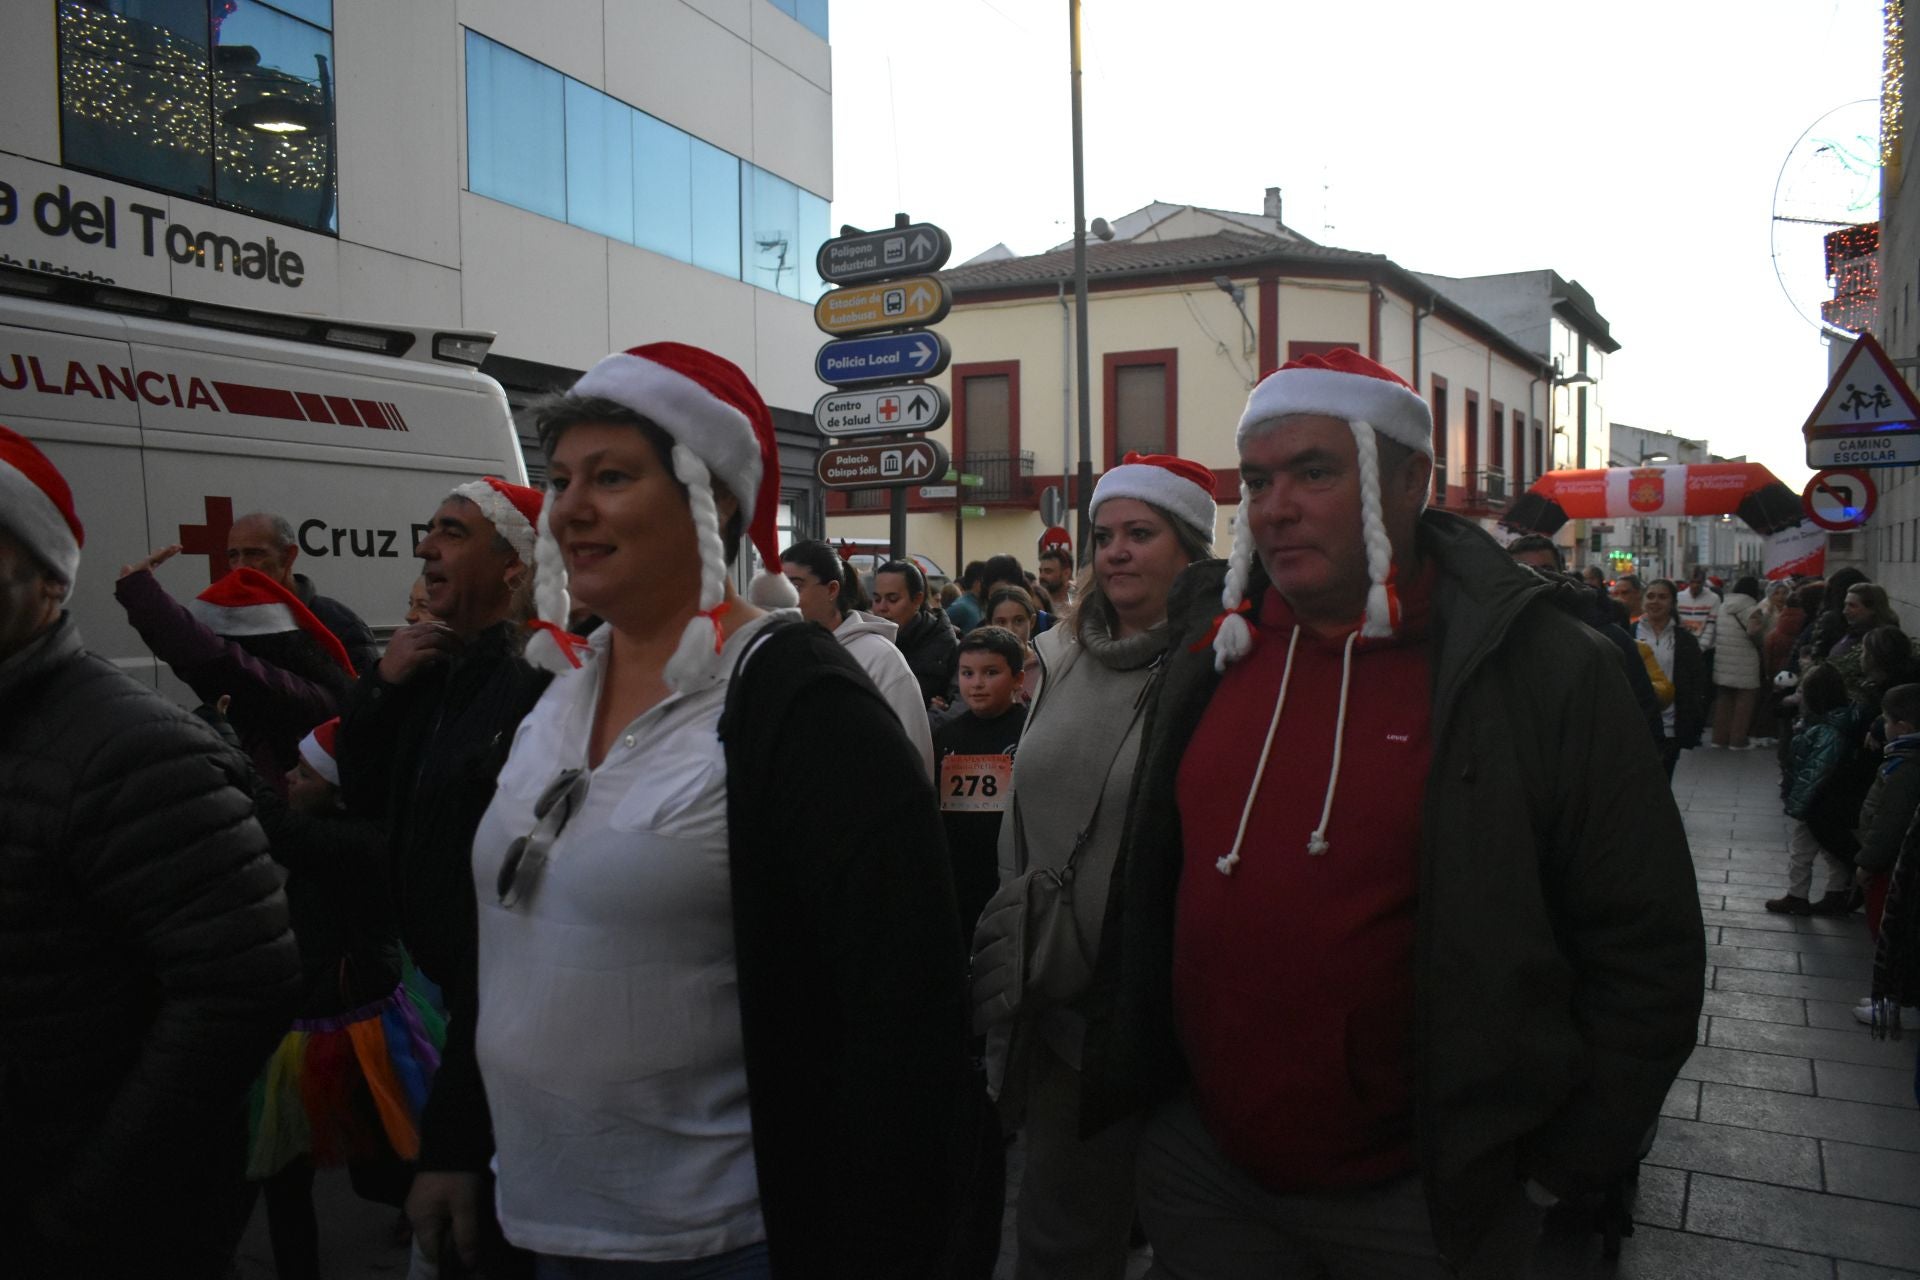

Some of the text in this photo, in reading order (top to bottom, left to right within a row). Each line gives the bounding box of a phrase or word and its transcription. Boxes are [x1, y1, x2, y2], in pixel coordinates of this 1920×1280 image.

[33, 185, 117, 249] del
[129, 203, 305, 289] Tomate
[831, 256, 877, 274] Industrial
[869, 292, 881, 303] de
[831, 310, 876, 324] Autobuses
[868, 350, 900, 366] Local
[827, 401, 862, 412] Centro
[827, 413, 871, 427] de Salud
[1838, 438, 1892, 451] CAMINO
[836, 454, 869, 465] Palacio
[1834, 450, 1896, 462] ESCOLAR
[827, 467, 858, 478] Obispo
[298, 518, 398, 558] Cruz
[950, 774, 998, 797] 278
